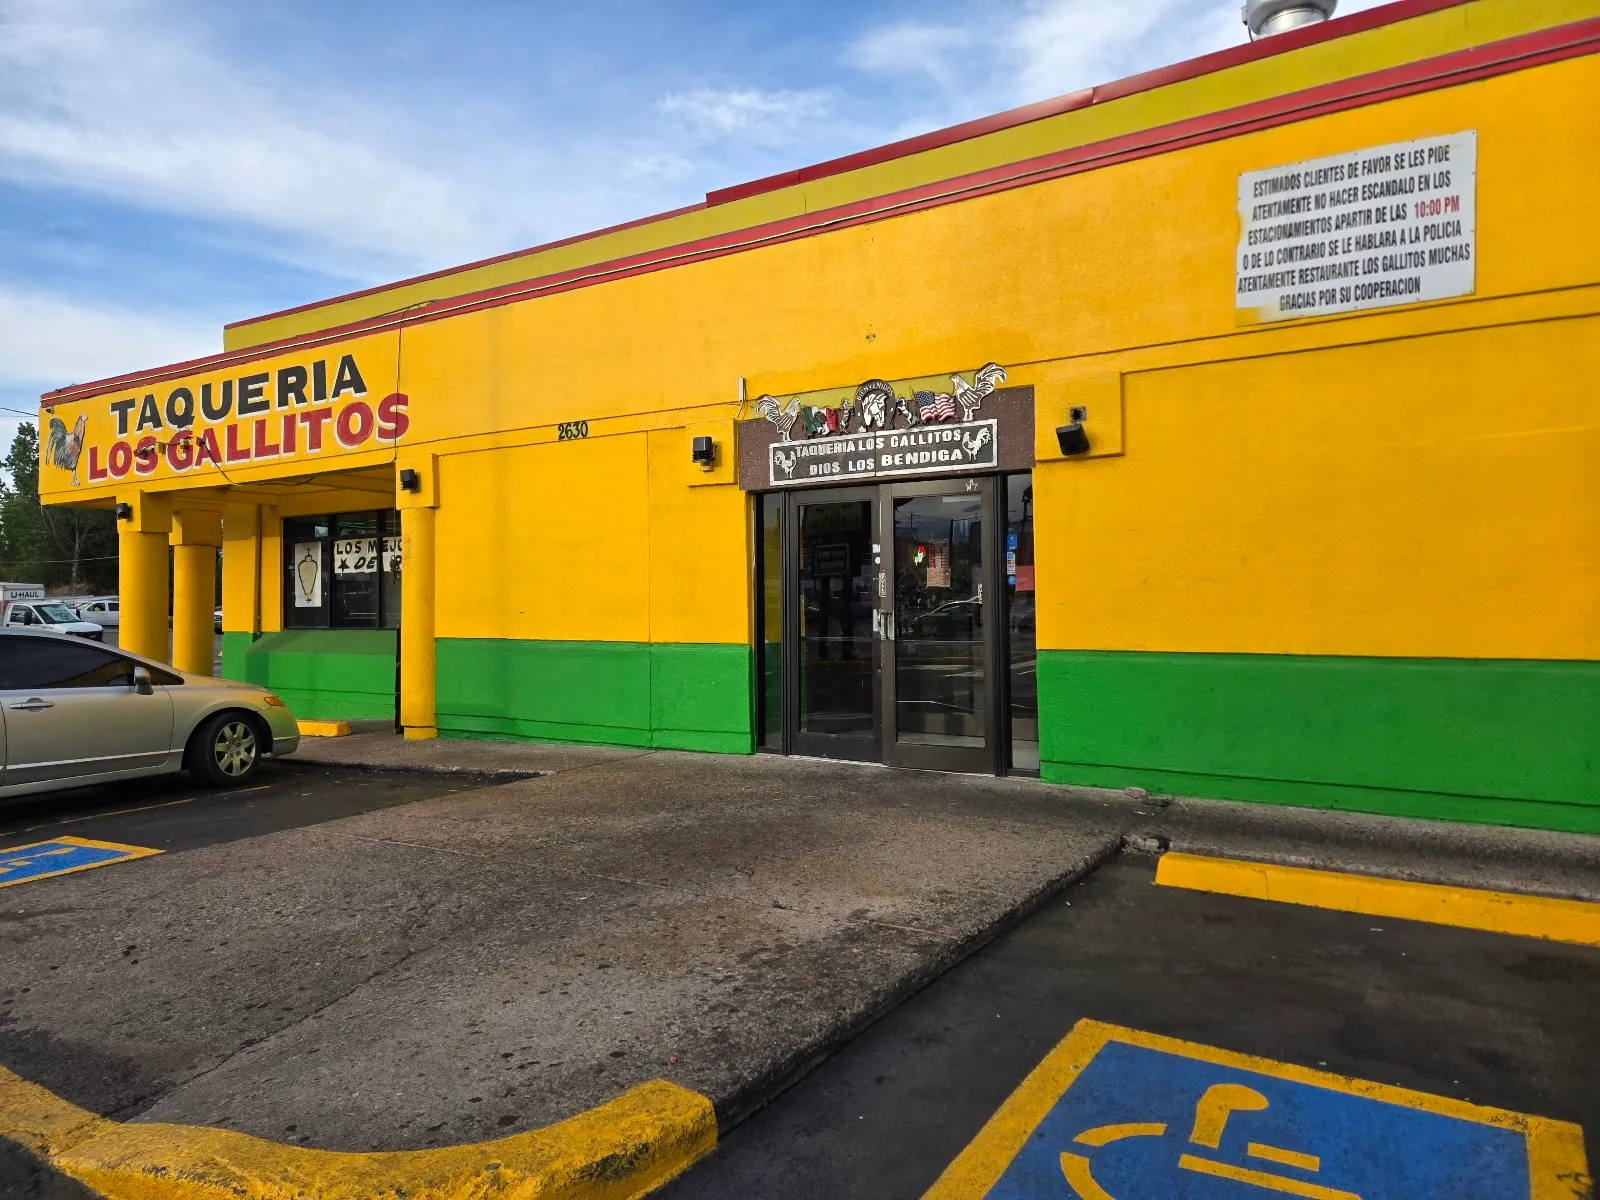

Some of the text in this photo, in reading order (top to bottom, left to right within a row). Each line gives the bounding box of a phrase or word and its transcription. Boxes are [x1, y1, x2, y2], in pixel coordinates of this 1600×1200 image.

[1254, 145, 1450, 198] ESTIMADOS CLIENTES DE FAVOR SE LES PIDE
[1252, 170, 1450, 221] ATENTAMENTE NO HACER ESCANDALO EN LOS
[1248, 195, 1460, 246] ESTACIONAMIENTOS APARTIR DE LAS 10:00 PM
[1243, 220, 1462, 270] O DE LO CONTRARIO SE LE HABLARA A LA POLICIA
[1238, 243, 1470, 293] ATENTAMENTE RESTAURANTE LOS GALLITOS MUCHAS
[1280, 276, 1420, 311] GRACIAS POR SU COOPERACION
[110, 354, 367, 436] TAQUERIA
[856, 382, 894, 401] BIENVENIDOS
[89, 393, 409, 482] LOS GALLITOS
[558, 421, 588, 440] 2630
[795, 429, 960, 458] TAQUERIA LOS GALLITOS
[810, 448, 963, 476] DIOS LOS BENDIGA
[336, 541, 361, 554] LOS
[354, 557, 377, 570] DE
